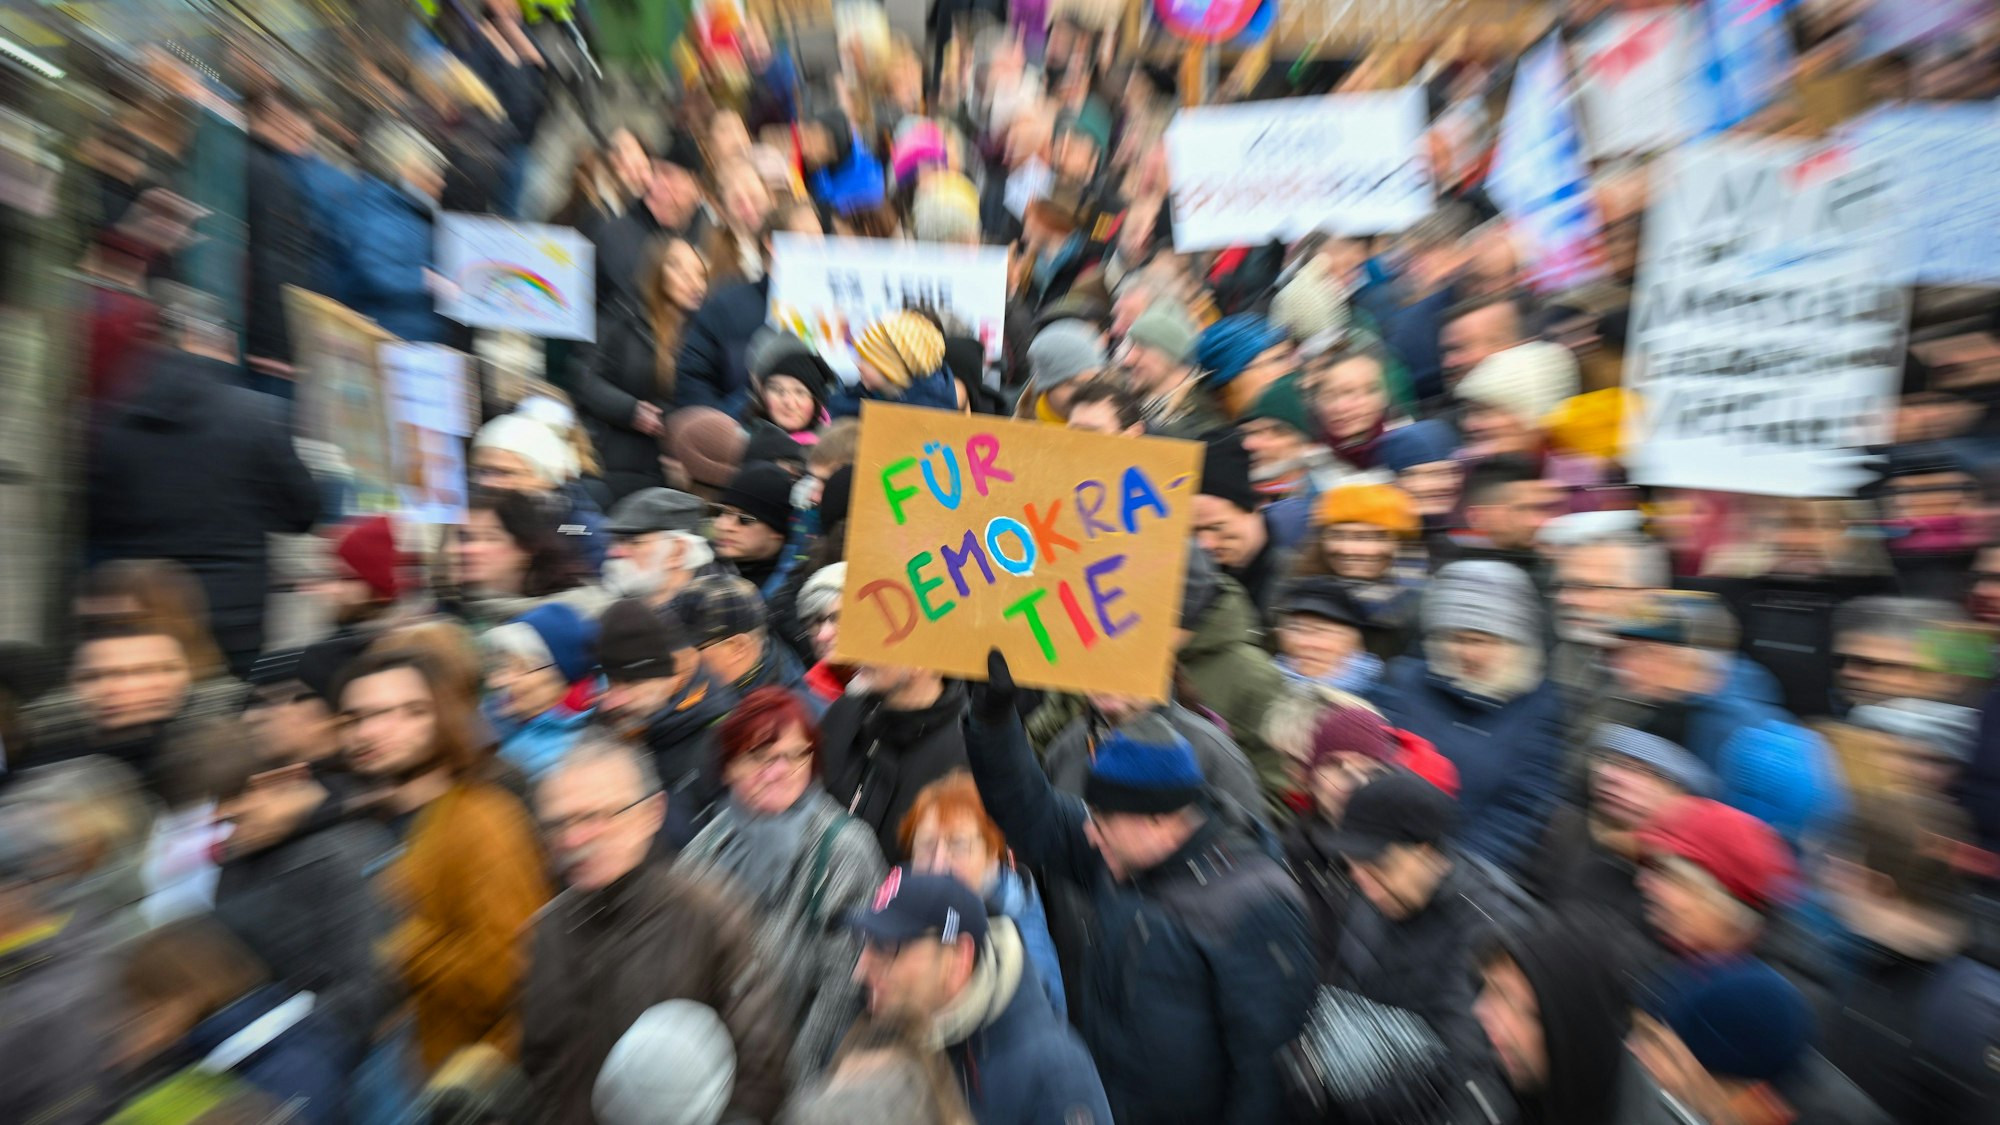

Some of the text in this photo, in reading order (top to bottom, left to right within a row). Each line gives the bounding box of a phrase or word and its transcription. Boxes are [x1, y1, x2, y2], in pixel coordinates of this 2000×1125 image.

[880, 432, 1015, 525] FÜR
[855, 465, 1190, 648] DEMOKRA-
[1003, 554, 1142, 666] TIE
